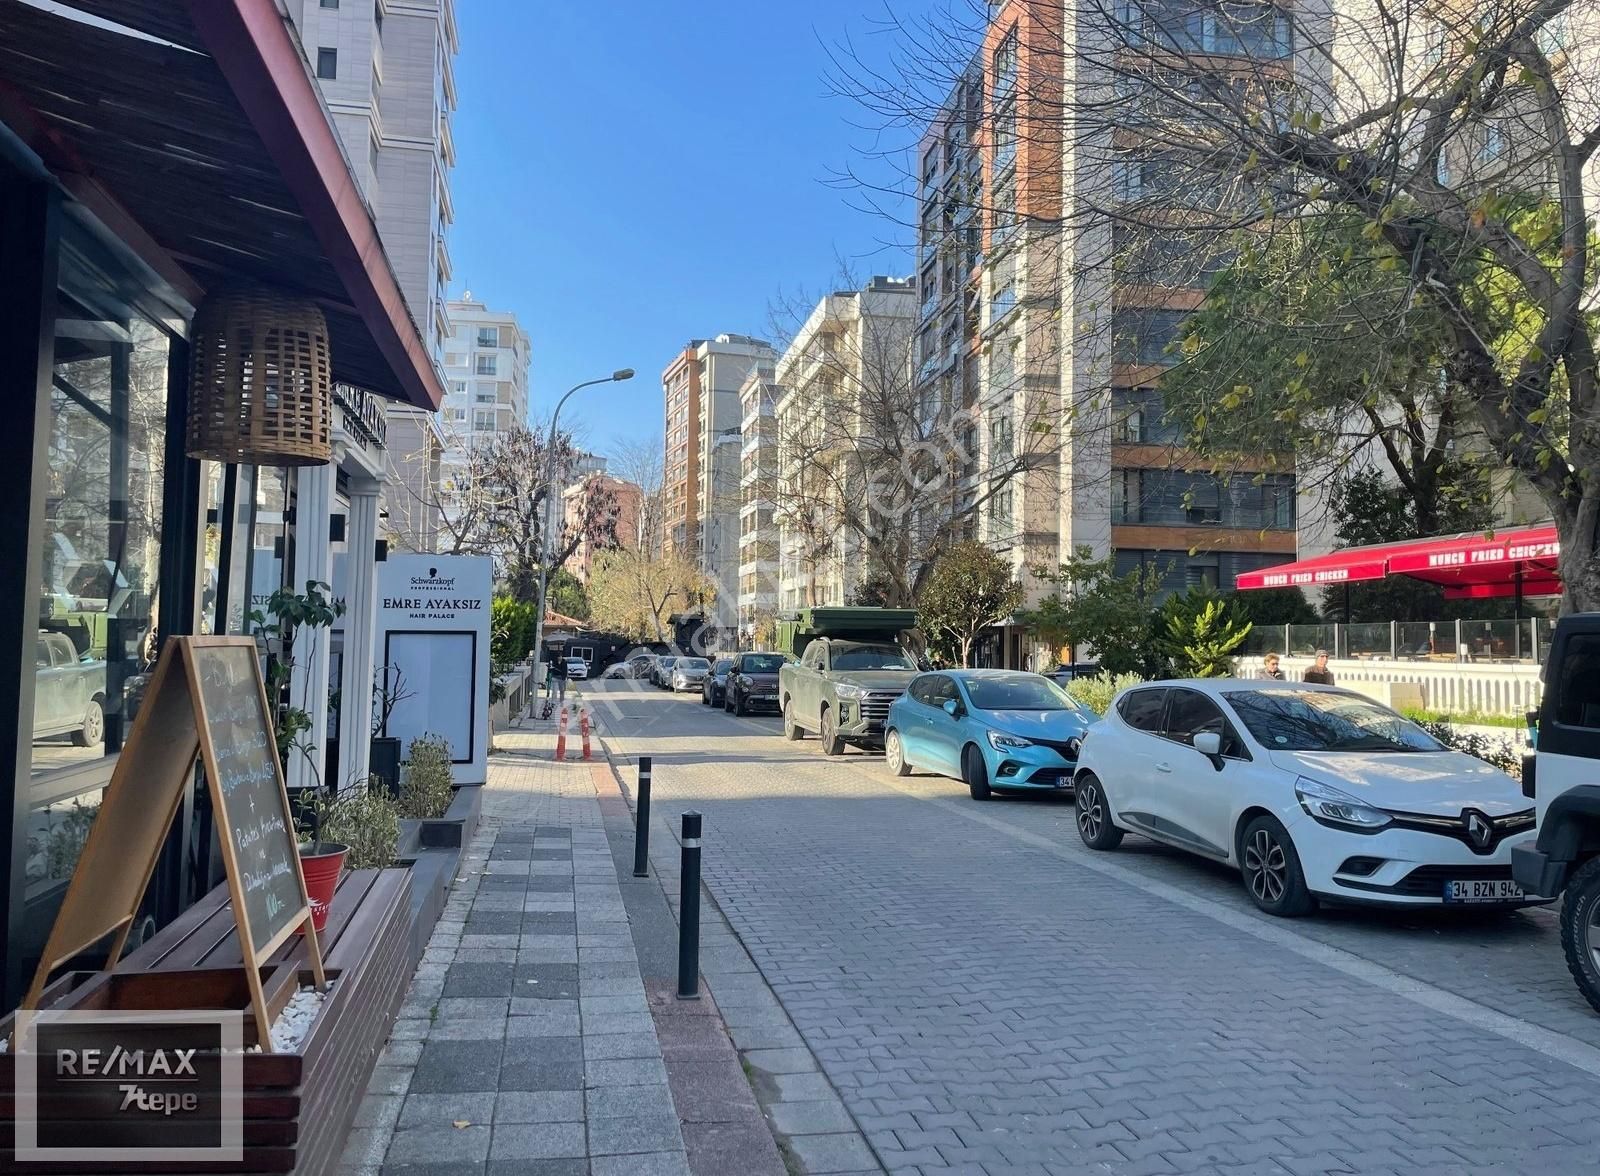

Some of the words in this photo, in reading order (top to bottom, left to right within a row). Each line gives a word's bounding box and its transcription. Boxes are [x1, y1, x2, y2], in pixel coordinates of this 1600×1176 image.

[1471, 549, 1504, 562] FRIED
[410, 577, 455, 587] Schwarzkopf
[383, 598, 421, 609] EMRE
[425, 599, 482, 610] AYAKSIZ
[1453, 882, 1468, 897] 34
[1474, 882, 1496, 897] BZN
[1500, 882, 1521, 897] 942
